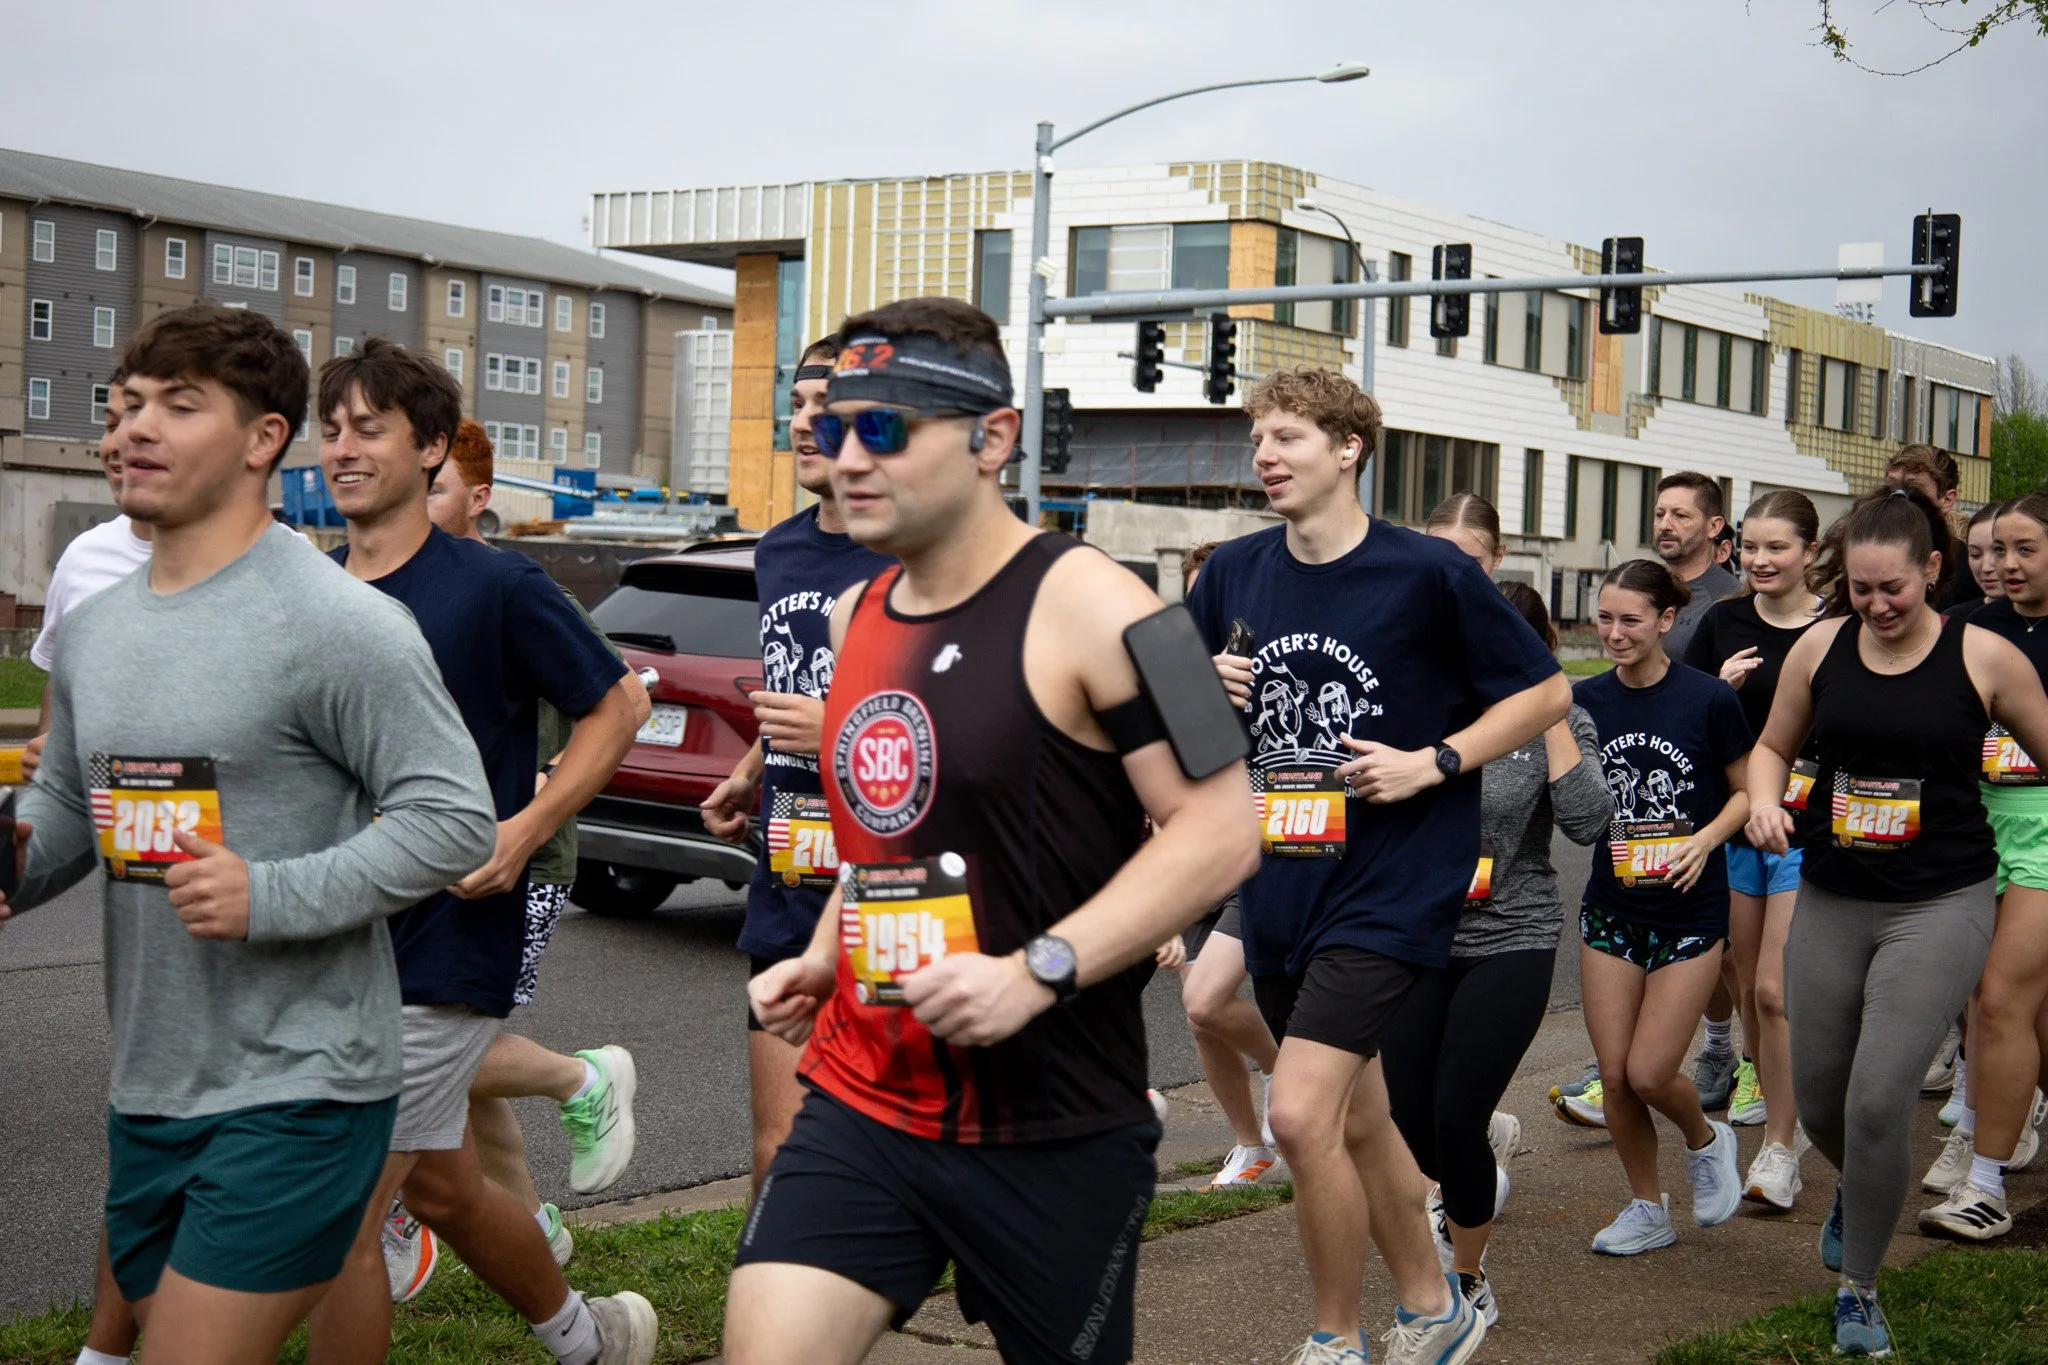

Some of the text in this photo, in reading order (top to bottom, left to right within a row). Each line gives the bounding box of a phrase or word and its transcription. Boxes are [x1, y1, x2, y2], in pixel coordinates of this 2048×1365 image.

[759, 591, 822, 646] OTTER'S
[1250, 633, 1380, 693] OTTER'S HOUSE
[1370, 704, 1384, 716] 26
[837, 697, 931, 778] SPRINGFIELD BREWING
[1600, 733, 1693, 775] OTTER'S HOUSE
[764, 753, 807, 770] ANNUAL
[859, 737, 909, 782] SBC
[1268, 798, 1329, 835] 2160
[1845, 801, 1908, 836] 2282
[793, 827, 840, 869] 216
[865, 911, 946, 972] 1954
